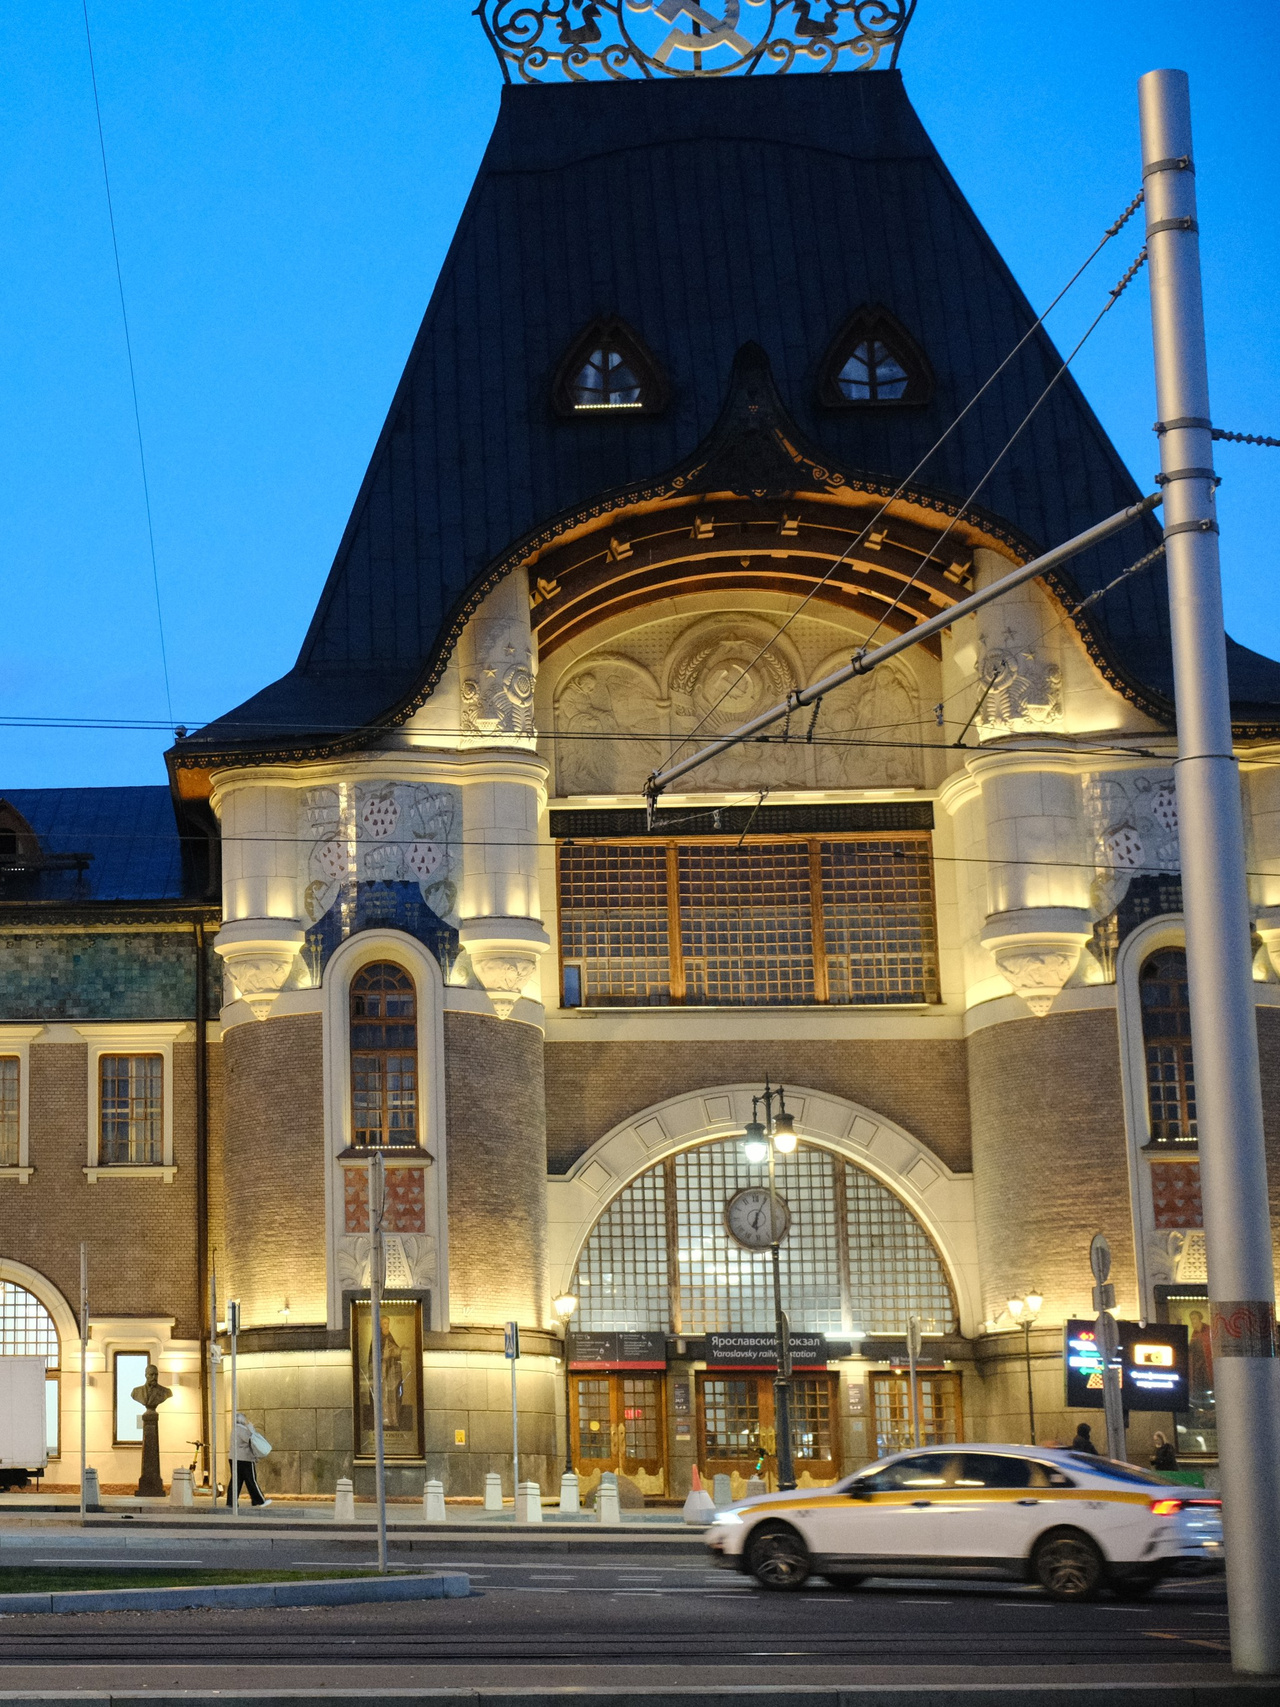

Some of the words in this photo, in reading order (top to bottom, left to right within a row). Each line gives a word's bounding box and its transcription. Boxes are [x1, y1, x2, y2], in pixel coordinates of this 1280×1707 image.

[789, 1338, 820, 1346] окзал
[713, 1350, 757, 1359] Yaroslavsky
[759, 1350, 778, 1358] railw
